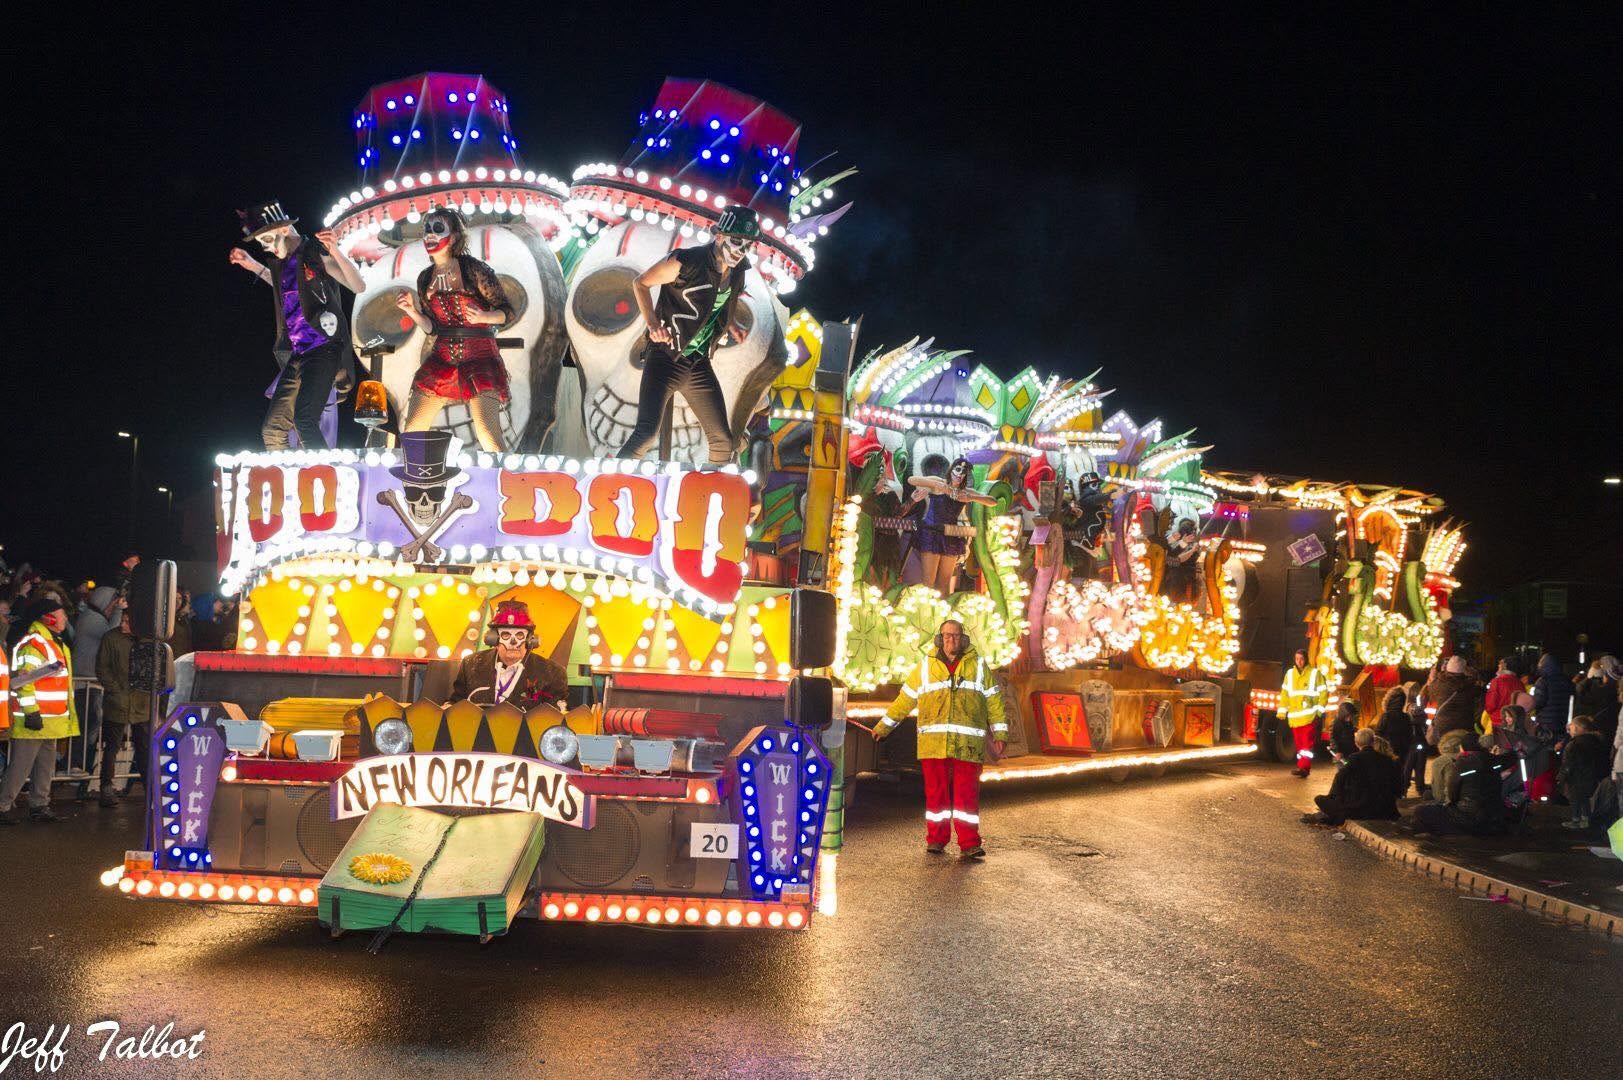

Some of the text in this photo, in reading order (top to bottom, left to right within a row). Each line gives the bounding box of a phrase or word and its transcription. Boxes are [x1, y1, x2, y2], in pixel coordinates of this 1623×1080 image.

[183, 733, 212, 844] WICK
[341, 754, 578, 822] NEW ORLEANS
[768, 761, 791, 871] WICK
[702, 834, 729, 853] 20
